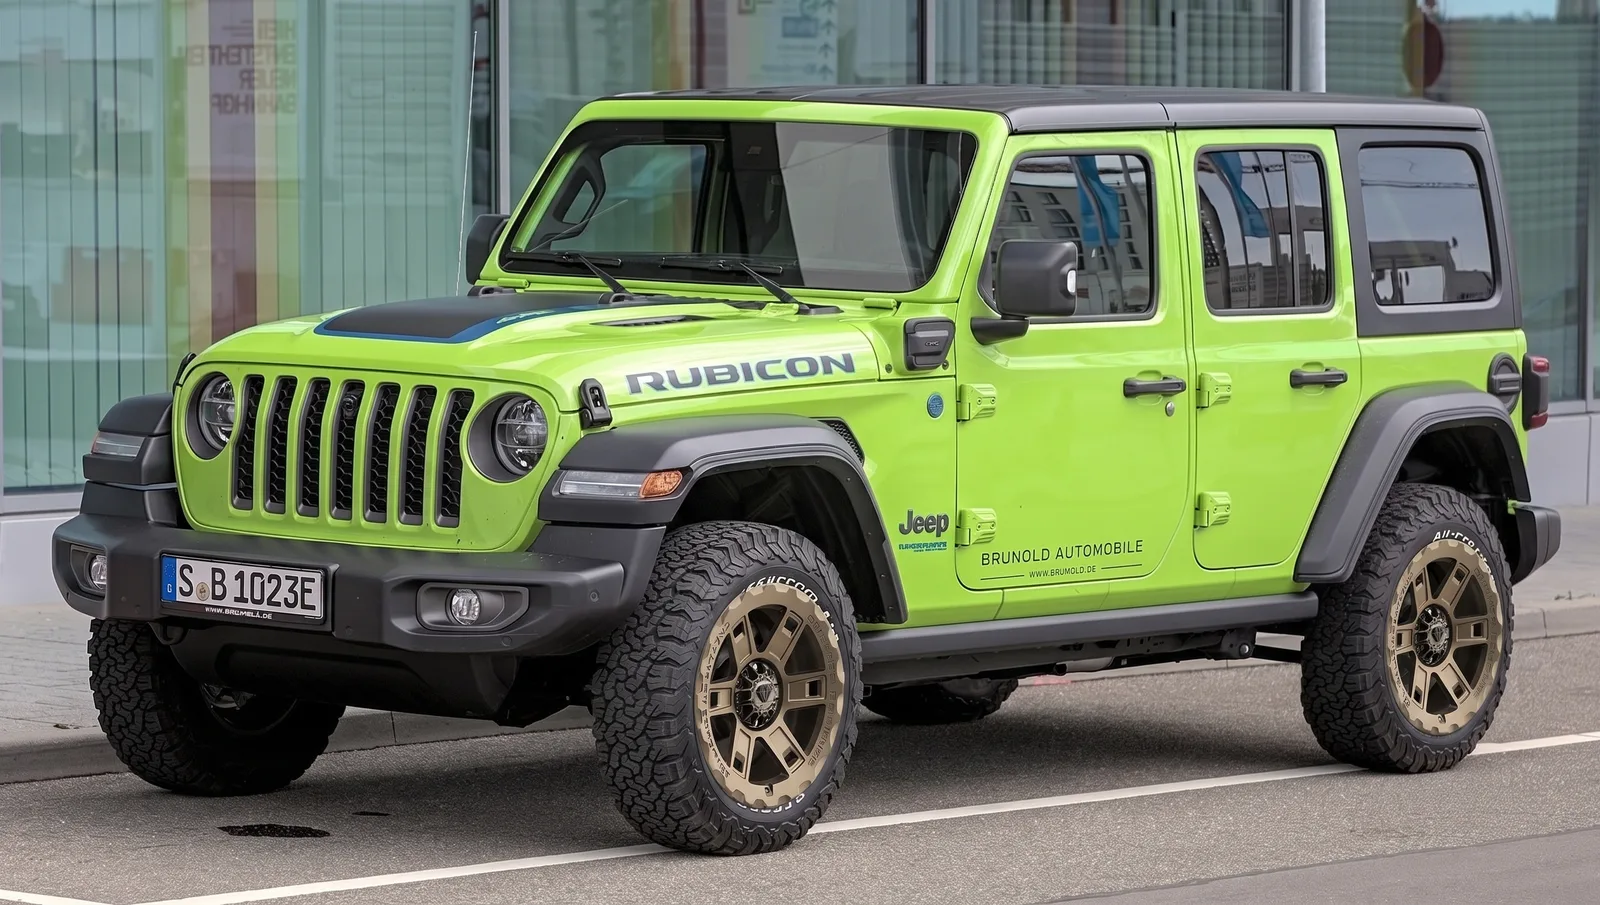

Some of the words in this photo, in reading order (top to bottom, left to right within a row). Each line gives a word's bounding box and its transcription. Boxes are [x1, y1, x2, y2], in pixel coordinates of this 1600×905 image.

[626, 353, 856, 394] RUBICON
[899, 509, 949, 538] Jeep
[981, 548, 1051, 566] BRUNOLD
[1055, 540, 1143, 560] AUTOMOBILE
[179, 564, 193, 597] S
